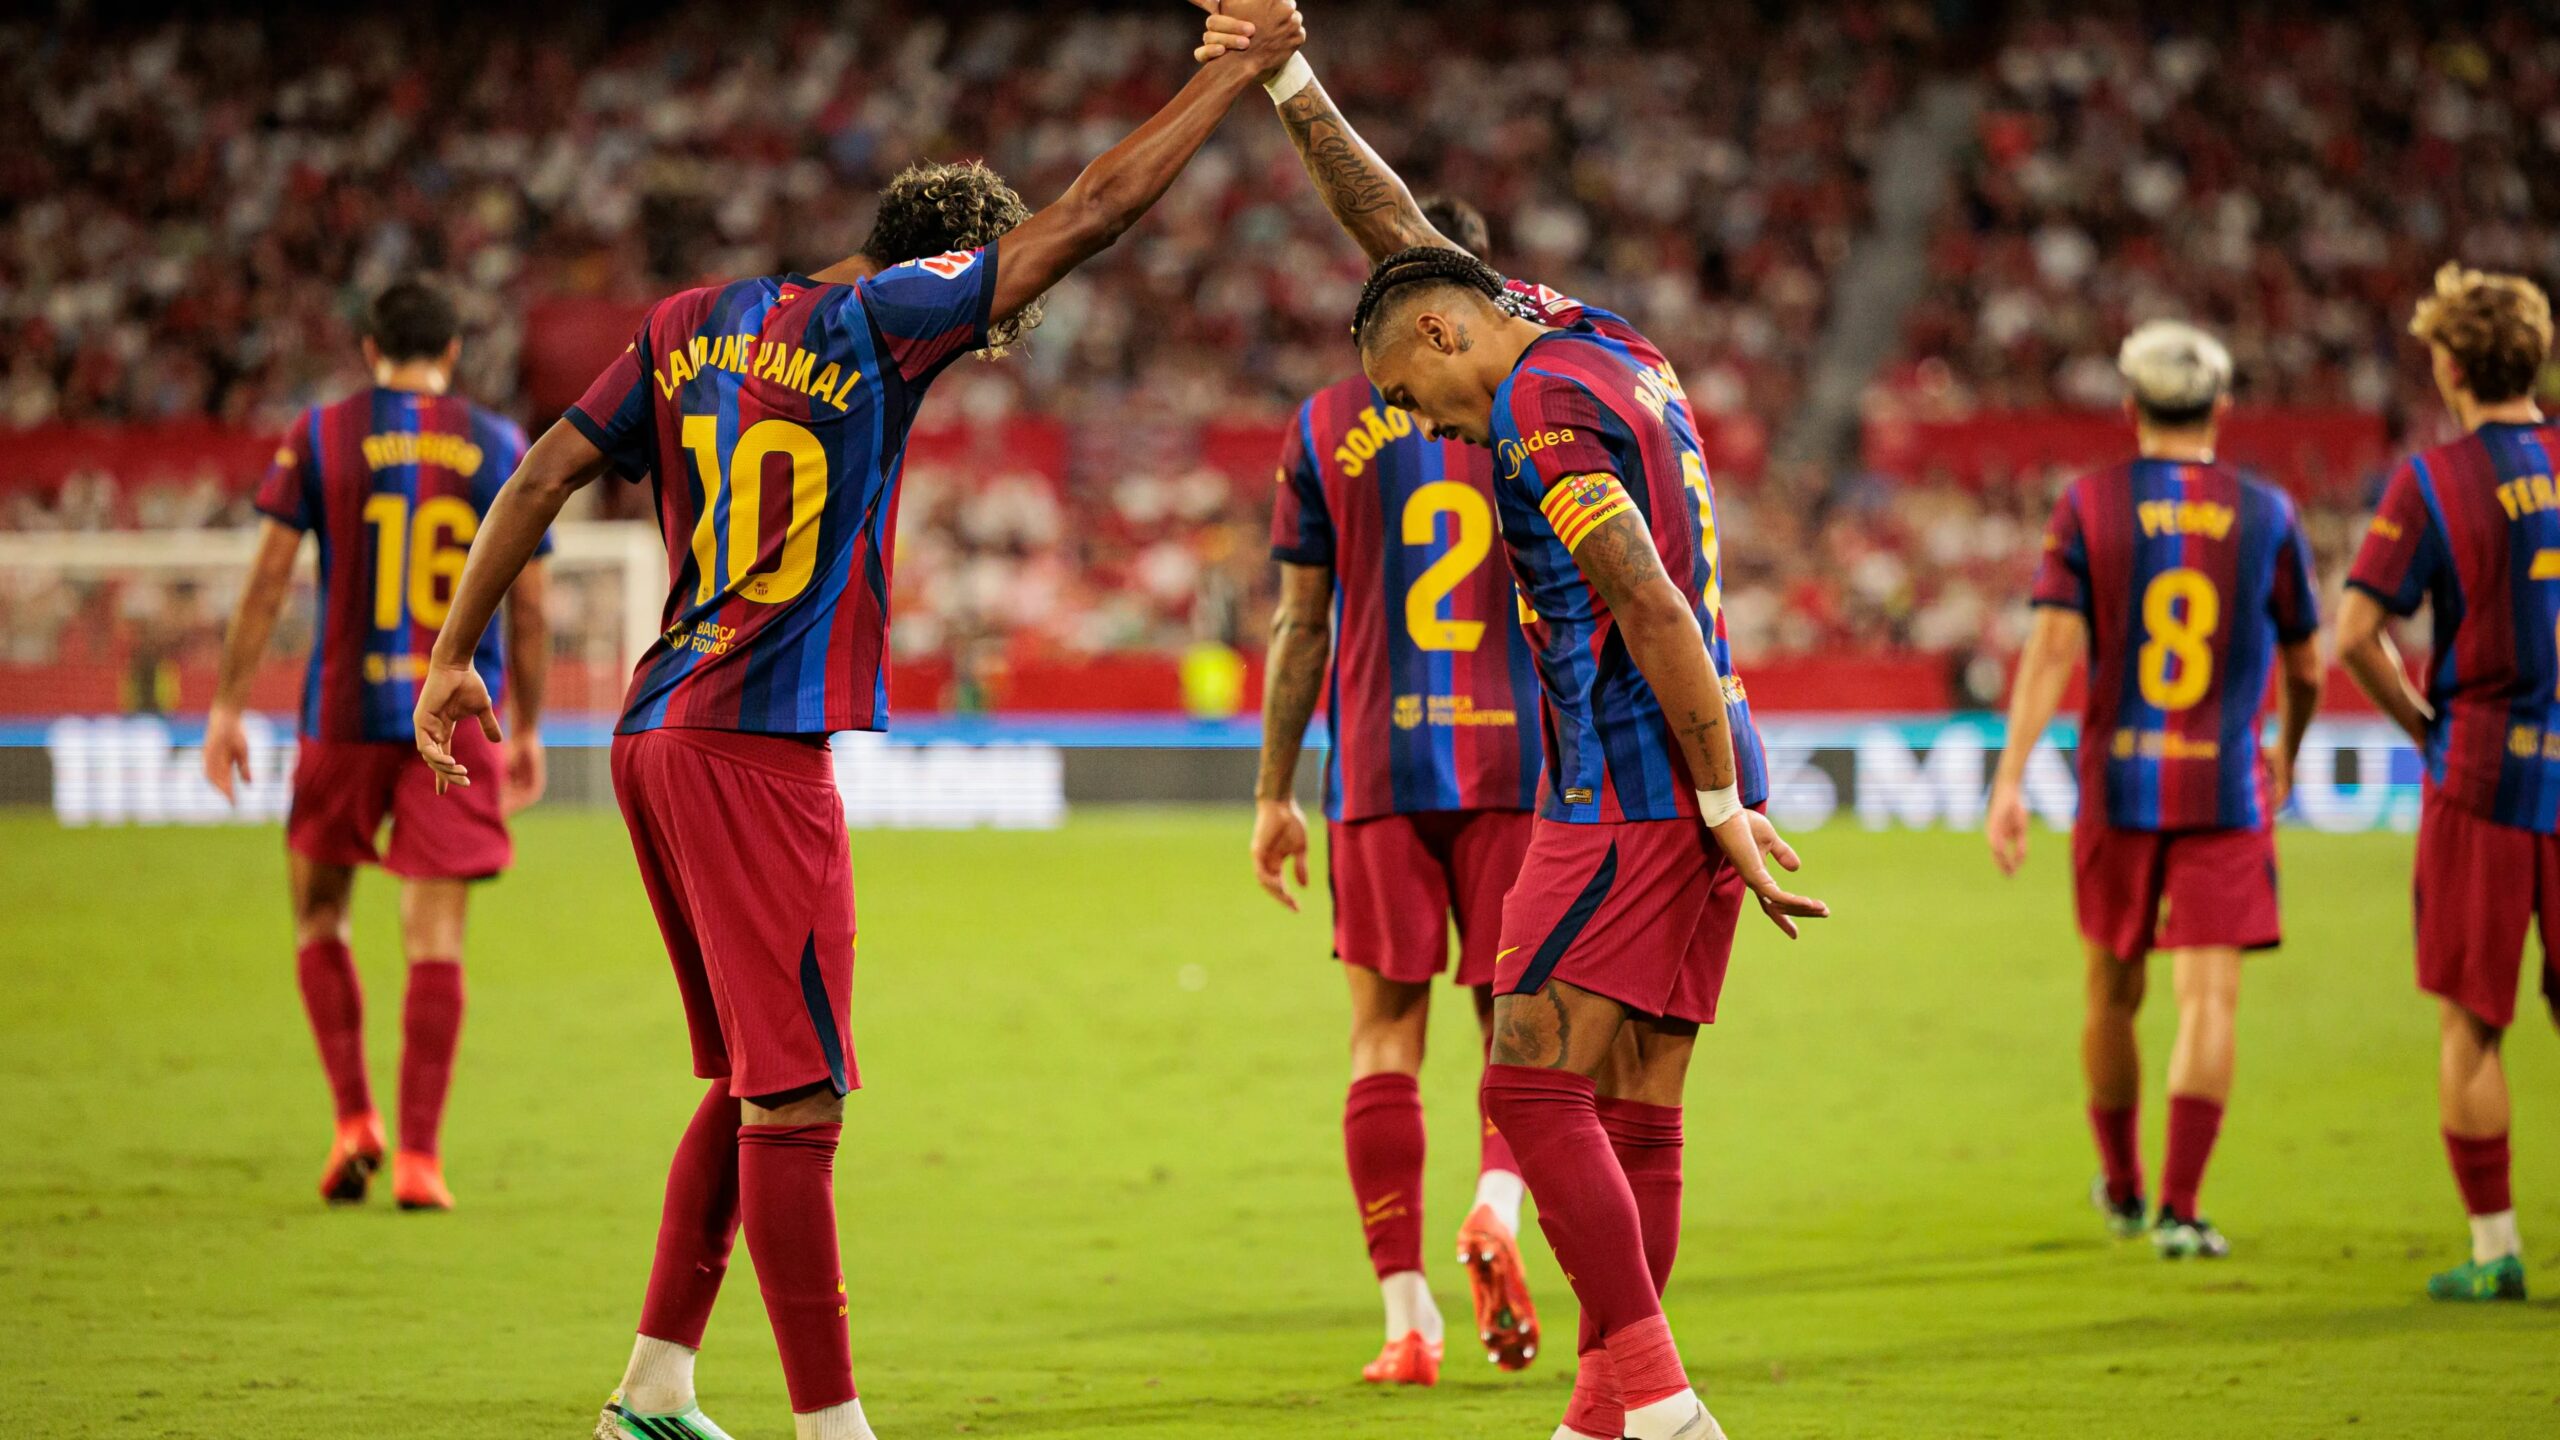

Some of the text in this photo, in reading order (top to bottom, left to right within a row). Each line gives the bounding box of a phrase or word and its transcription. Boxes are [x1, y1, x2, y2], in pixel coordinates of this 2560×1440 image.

[654, 333, 862, 412] LAMINE YAMAL
[1334, 405, 1413, 477] JOÃO
[1498, 427, 1575, 480] Midea
[363, 493, 480, 631] 16
[681, 415, 828, 605] 10
[1402, 480, 1493, 651] 2
[696, 620, 736, 642] BARÇA
[2138, 568, 2219, 710] 8
